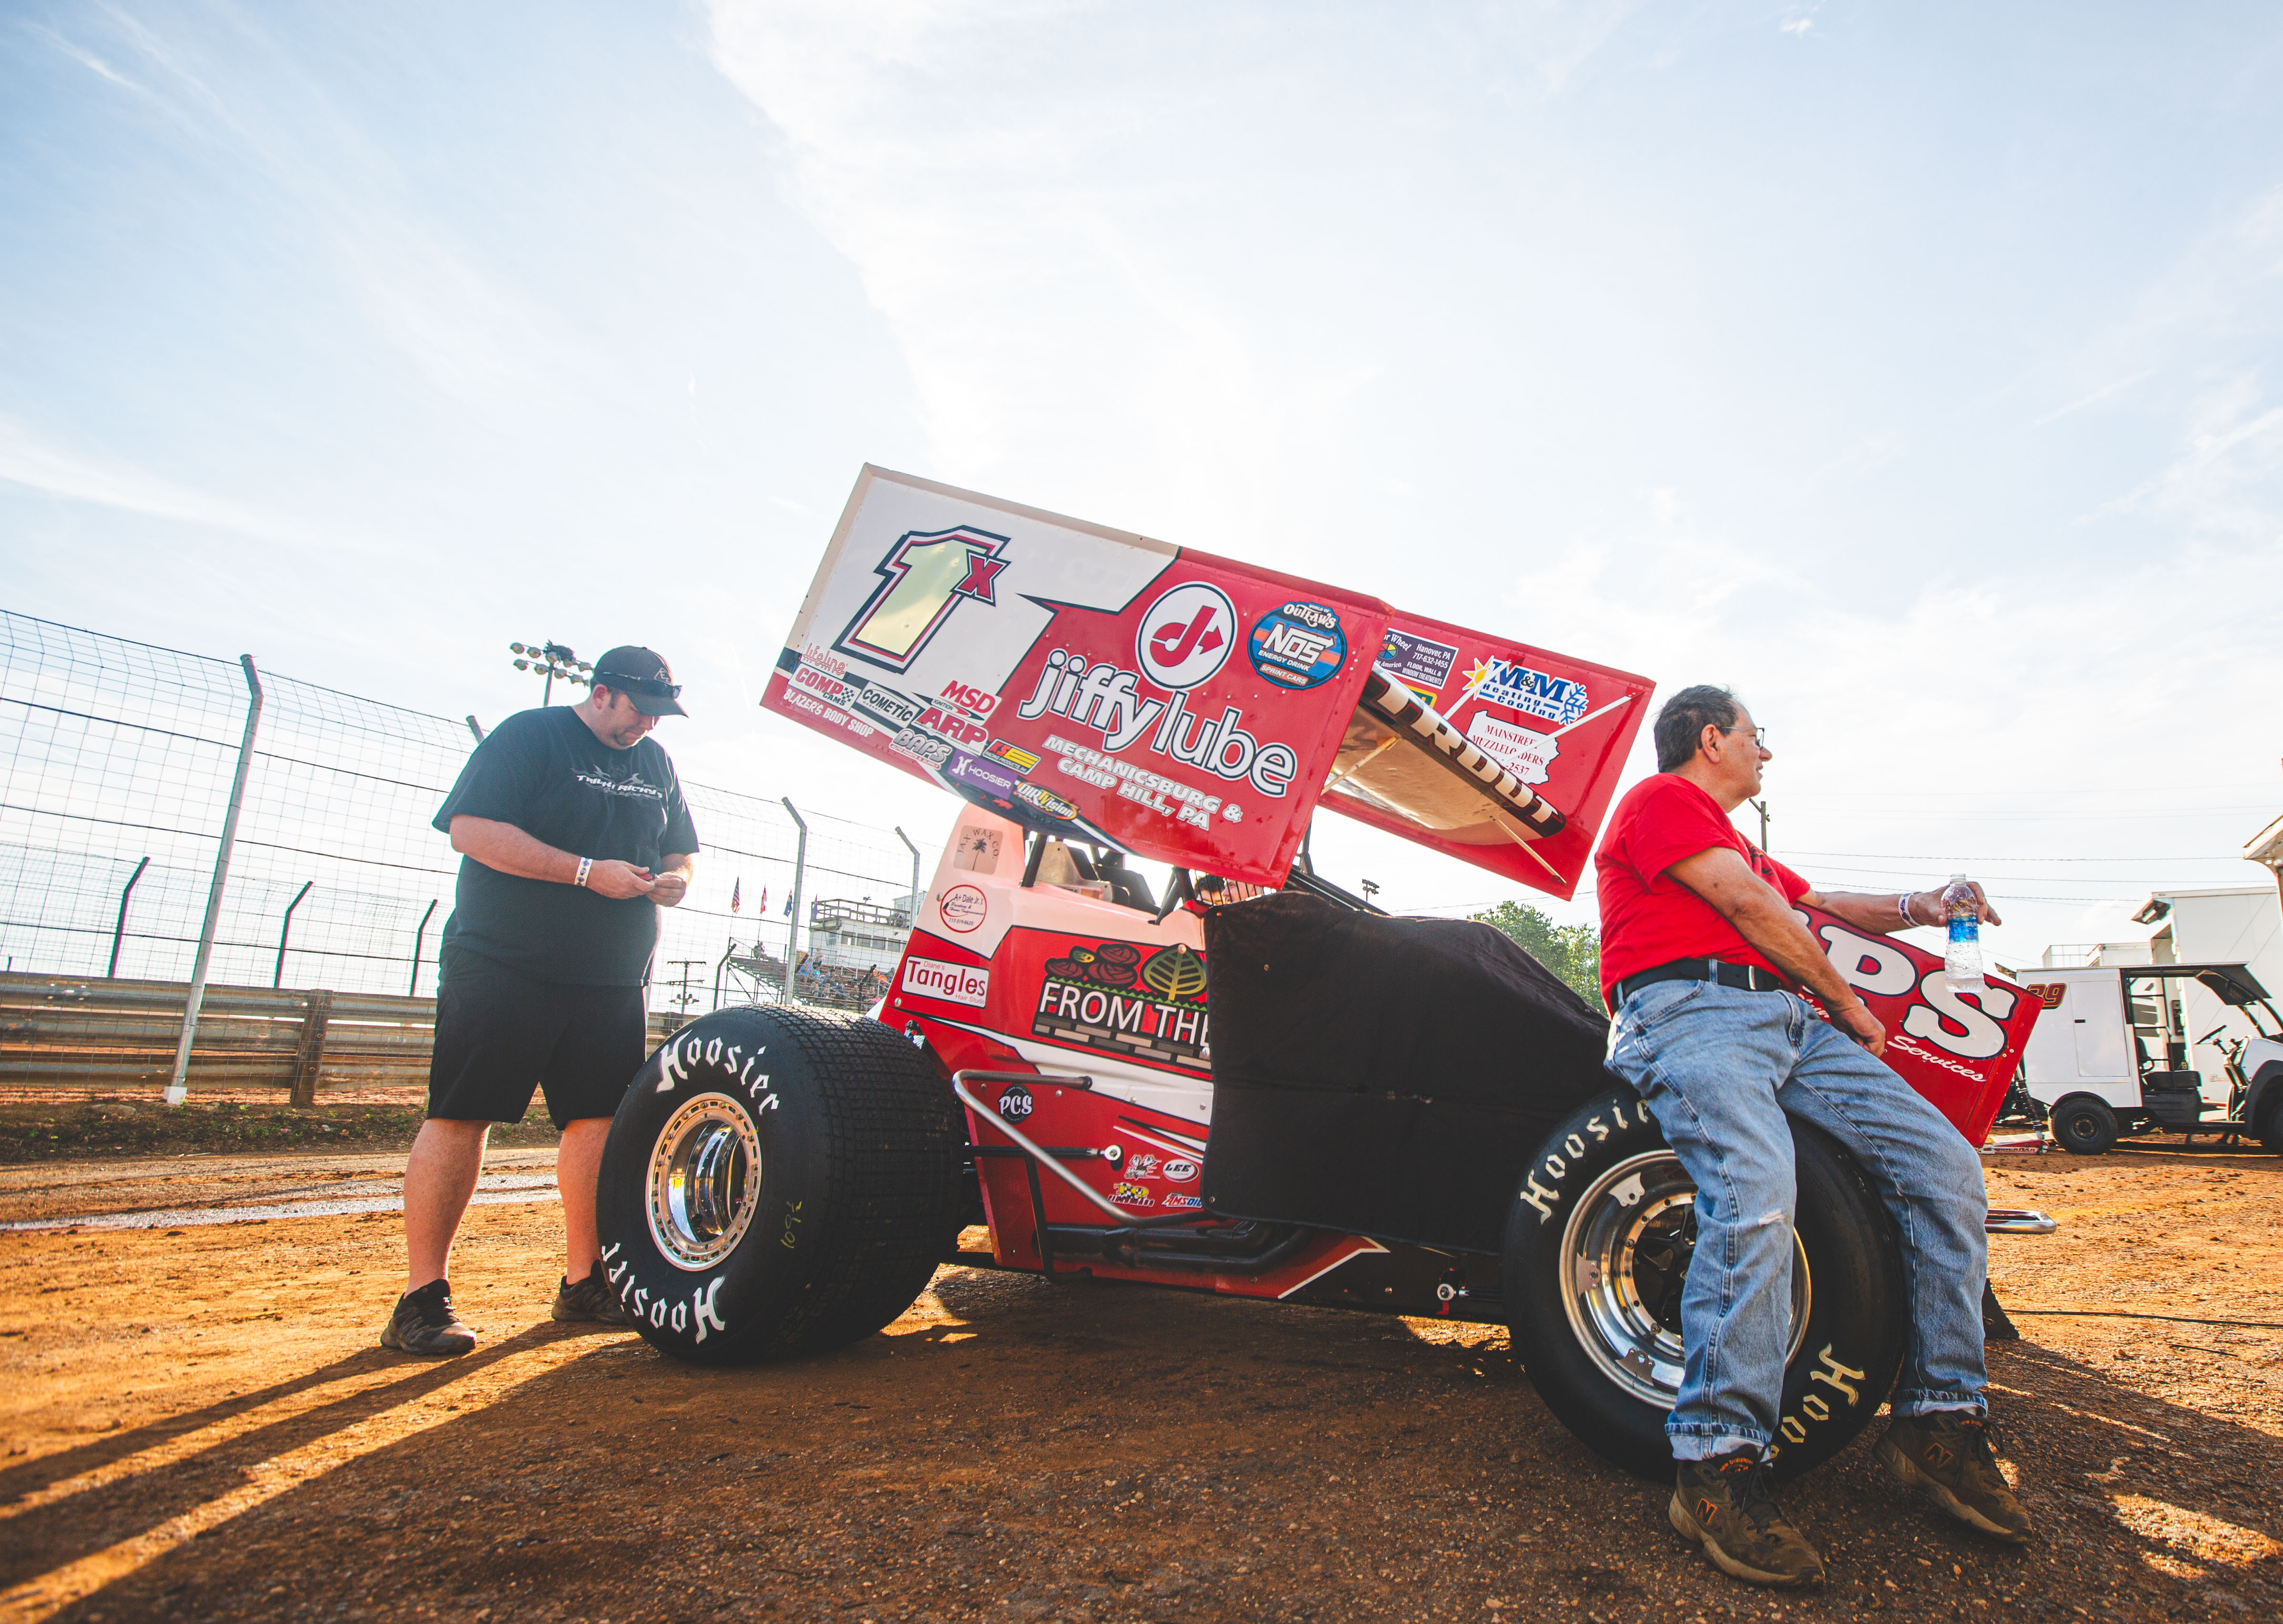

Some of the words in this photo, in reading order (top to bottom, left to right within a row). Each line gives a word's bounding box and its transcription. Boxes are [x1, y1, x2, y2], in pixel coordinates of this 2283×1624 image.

[1263, 623, 1335, 664] NOS
[1390, 634, 1412, 651] Wheel
[1416, 643, 1442, 658] Hanover,
[1442, 651, 1451, 660] PA
[1258, 650, 1287, 663] ENERGY
[1287, 660, 1311, 671] DRINK
[1406, 661, 1423, 671] FLOOR,
[1424, 666, 1437, 675] WALL
[1413, 652, 1449, 669] 717-632-1455
[795, 668, 844, 695] COMP
[1260, 665, 1287, 678] SPRINT
[1287, 674, 1307, 684] CARS
[1402, 667, 1418, 678] WINDOW
[1418, 672, 1443, 686] TREATMENTS
[823, 692, 847, 706] CAMS
[862, 689, 913, 721] COMETIC
[862, 700, 881, 712] GASKET
[933, 699, 954, 710] IGNITION
[940, 680, 996, 714] MSD
[1482, 683, 1541, 706] Heating
[783, 688, 824, 715] BLAZER'S
[823, 707, 850, 727] BODY
[847, 719, 874, 737] SHOP
[1497, 695, 1556, 719] Cooling
[916, 707, 987, 745] ARP
[893, 729, 951, 763] BAPS
[984, 751, 999, 761] RACING
[988, 740, 1040, 769] KSE
[968, 766, 1011, 789] HOOSIER
[1041, 734, 1222, 814] MECHANICSBURG
[1222, 803, 1243, 823] &
[1057, 757, 1117, 790] CAMP
[1116, 780, 1176, 817] HILL,
[1176, 803, 1210, 831] PA
[957, 834, 971, 854] JAX
[973, 828, 993, 840] WAX
[962, 894, 973, 903] Dale
[924, 961, 945, 971] Diane's
[908, 960, 986, 996] Tangles
[969, 996, 985, 1005] Studio
[1040, 982, 1143, 1033] FROM
[1887, 1035, 1987, 1082] Services
[656, 1029, 779, 1116] Hoosier
[999, 1095, 1032, 1115] PCS
[1164, 1164, 1192, 1172] LEE
[1520, 1099, 1649, 1225] Hoosie
[601, 1243, 725, 1344] Hoosier
